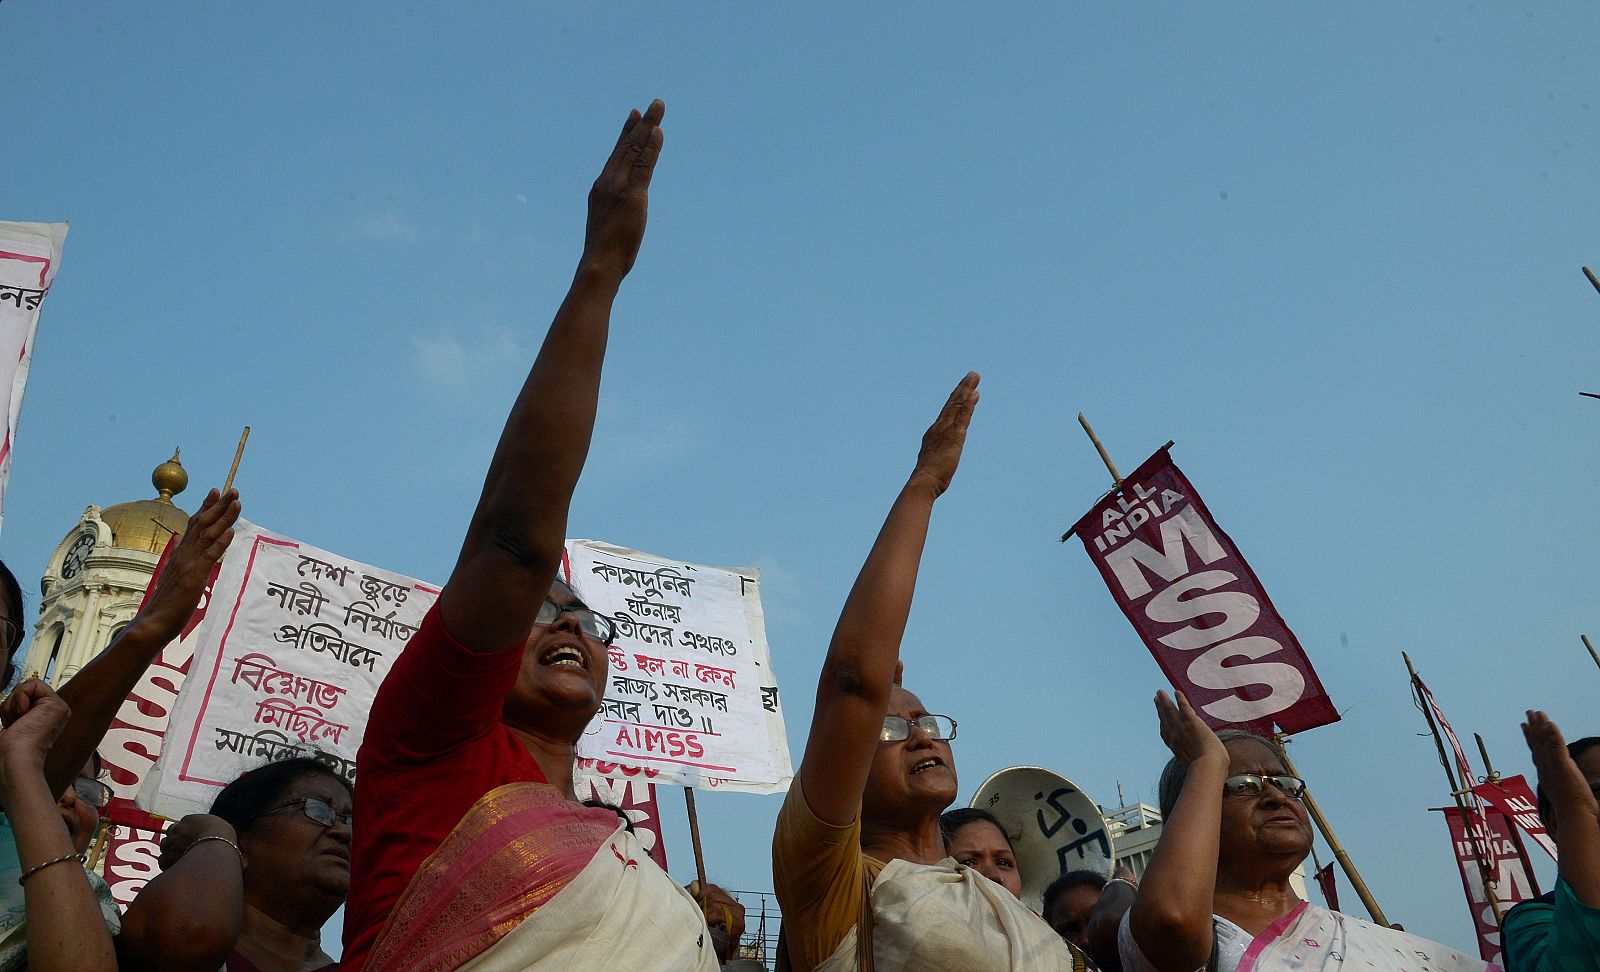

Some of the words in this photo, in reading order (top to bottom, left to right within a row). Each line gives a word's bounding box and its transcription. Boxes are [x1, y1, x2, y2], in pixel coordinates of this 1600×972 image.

[1094, 488, 1184, 552] INDIA
[1102, 483, 1157, 528] ALL
[297, 555, 354, 587] দেশ
[360, 575, 410, 609] জুড়ে
[592, 561, 695, 599] কামদুনির
[267, 582, 330, 617] নারী
[344, 601, 420, 640] নির্যাত
[625, 592, 682, 624] ঘটনায়
[1104, 502, 1306, 723] MSS
[274, 623, 382, 672] প্রতিবাদে
[679, 631, 737, 656] এখনও
[232, 653, 347, 709] বিক্ষোভ
[634, 654, 666, 677] হল
[670, 659, 690, 679] না
[694, 664, 737, 690] কেন
[613, 676, 658, 701] রাজ্য
[663, 683, 728, 713] সরকার
[254, 698, 349, 745] মিছিলে
[216, 728, 307, 762] সামিল
[616, 726, 705, 759] AIMSS
[1504, 795, 1537, 812] ALL
[1513, 812, 1545, 829] IND
